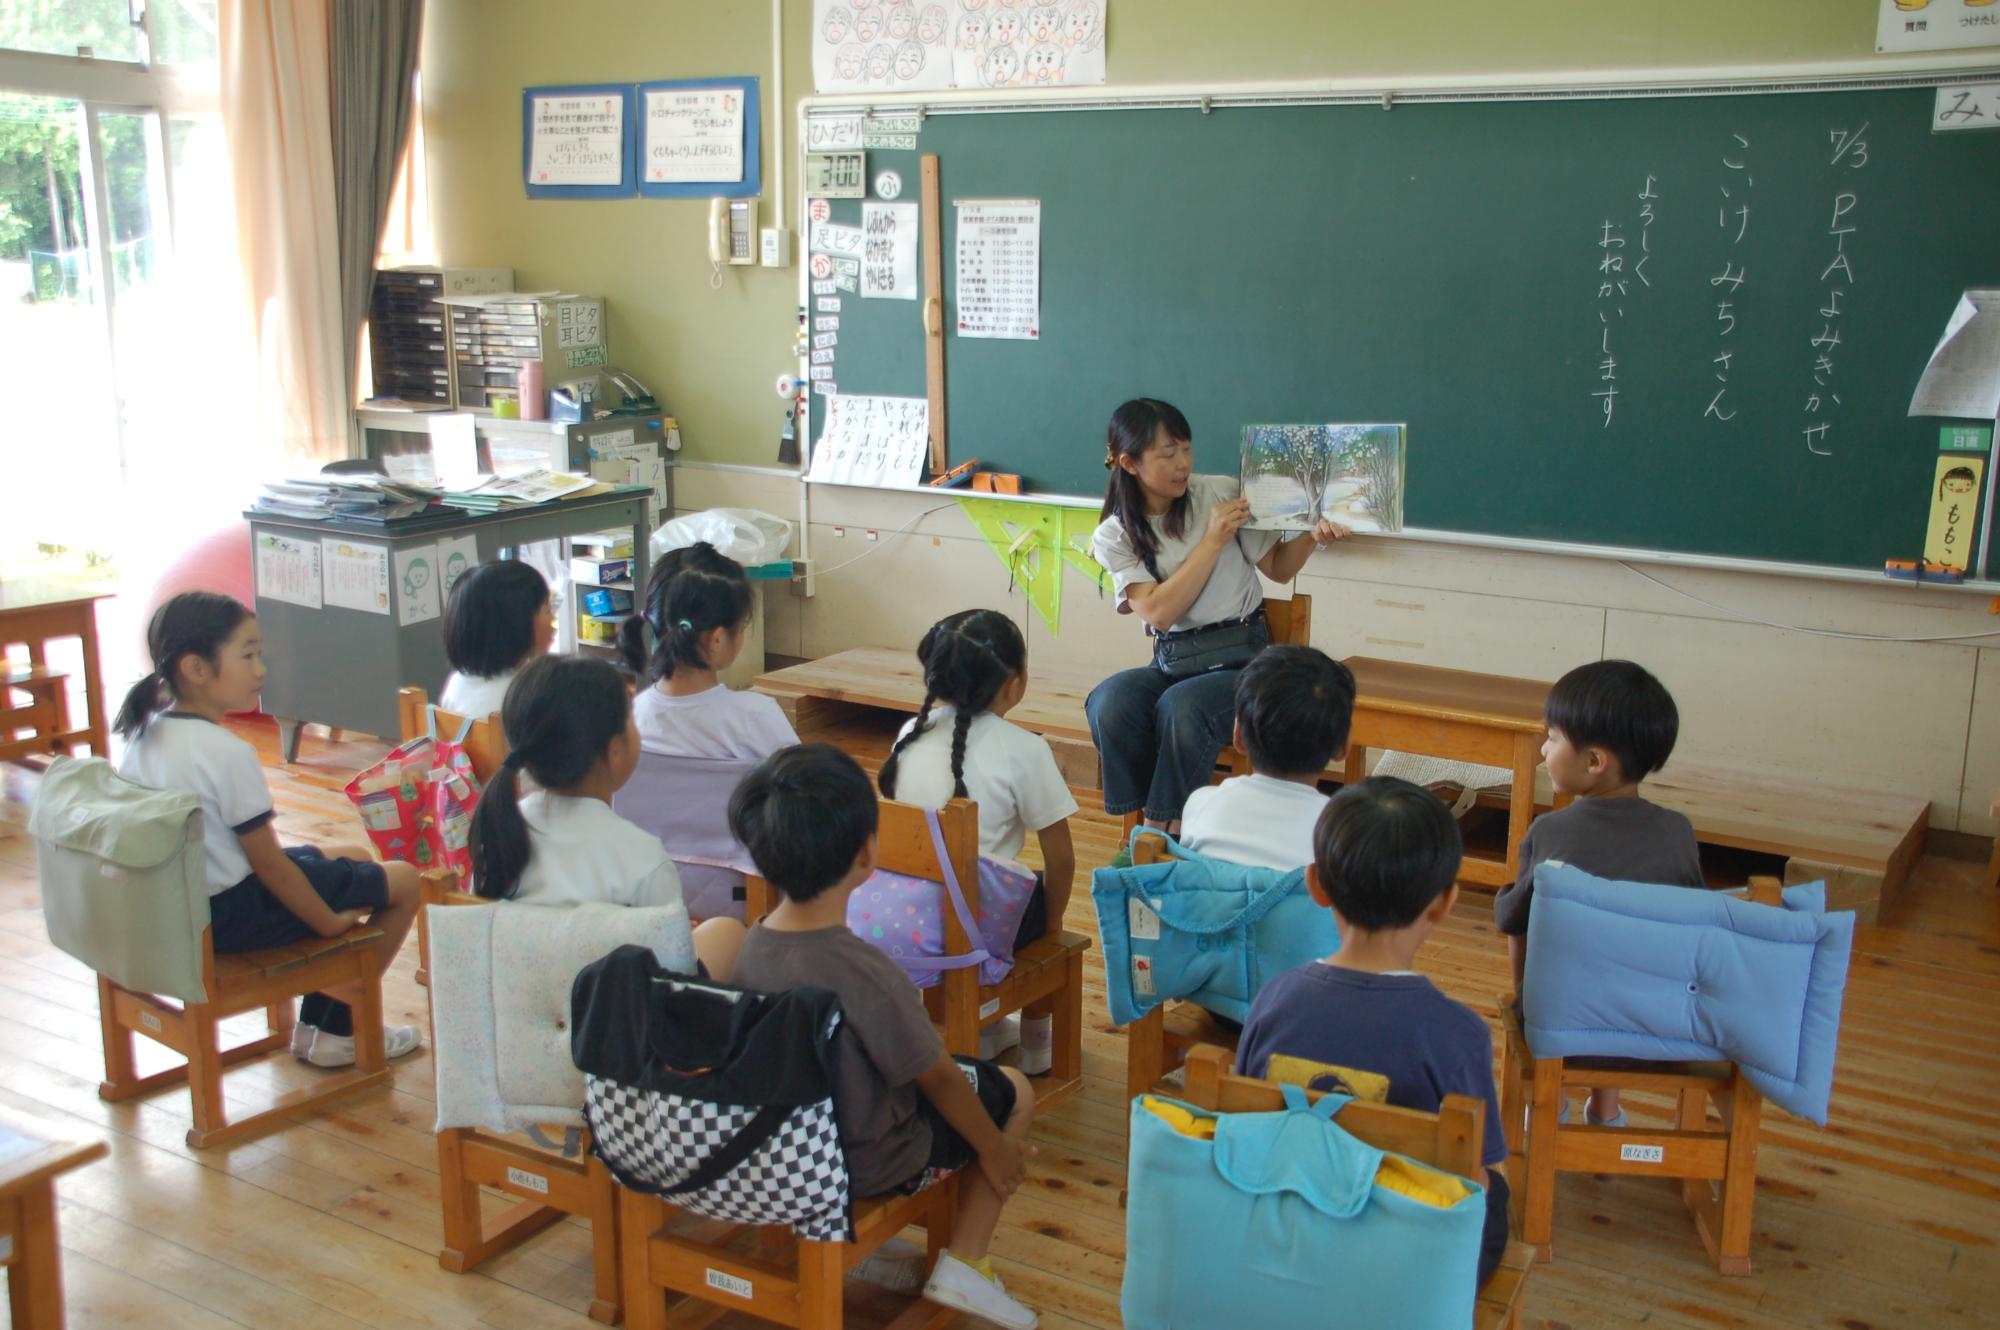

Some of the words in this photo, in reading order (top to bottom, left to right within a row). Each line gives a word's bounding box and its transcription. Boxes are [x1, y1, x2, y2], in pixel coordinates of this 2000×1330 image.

[1904, 21, 1928, 32] 質問
[1959, 14, 1998, 27] つけたし
[812, 120, 860, 145] ひだり
[1829, 121, 1869, 167] 7/3
[881, 175, 897, 196] ふ
[813, 203, 828, 221] ま
[866, 210, 897, 235] じぶんから
[817, 228, 862, 252] 足ピタ
[1634, 175, 1659, 287] よろしく
[865, 239, 895, 263] なかまと
[814, 257, 830, 277] か
[866, 266, 896, 291] やりきる
[561, 307, 597, 324] 目ピタ
[1591, 219, 1629, 428] おねがいします
[561, 326, 598, 344] 耳ピタ
[877, 400, 894, 471] やっぱり
[1954, 435, 1979, 448] 日直
[1939, 503, 1961, 567] ももこ
[408, 603, 428, 618] かく
